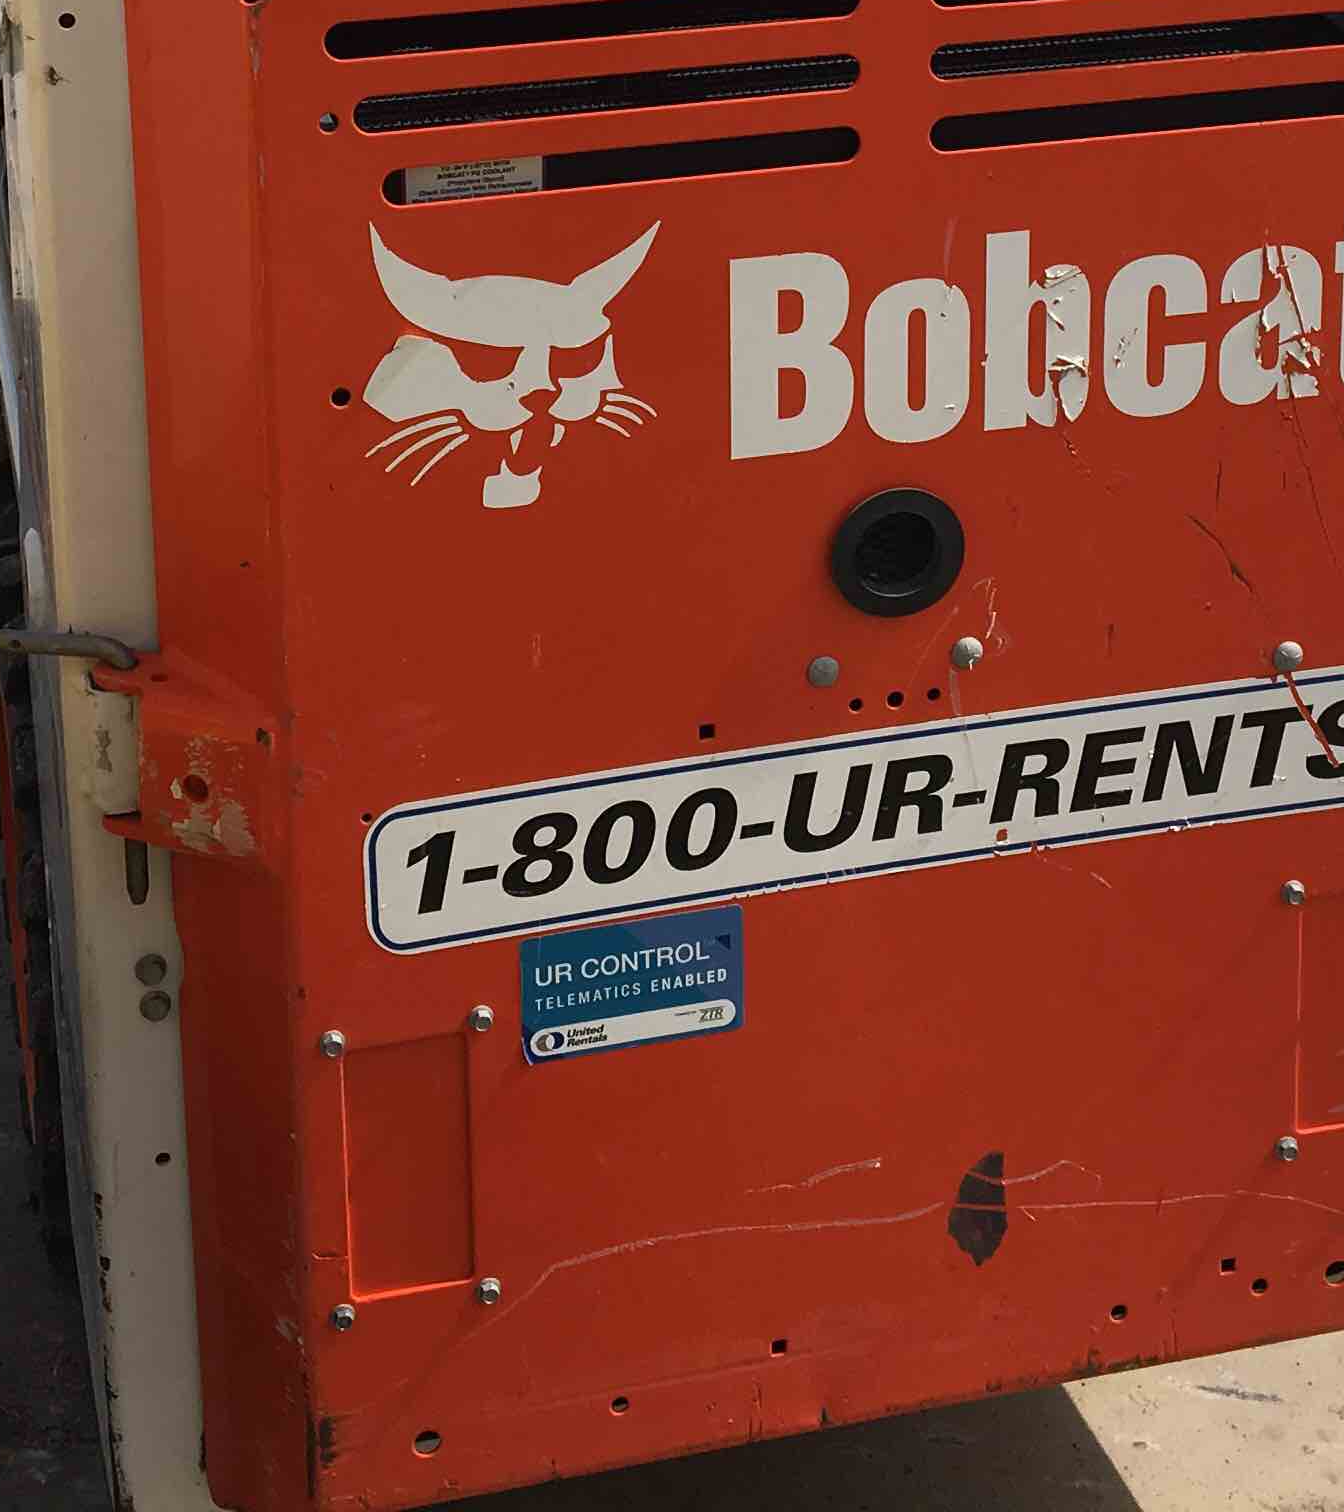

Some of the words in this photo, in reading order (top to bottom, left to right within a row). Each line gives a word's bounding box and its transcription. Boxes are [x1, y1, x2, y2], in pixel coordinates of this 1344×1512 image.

[535, 963, 572, 986] UR
[581, 941, 710, 979] CONTROL
[536, 983, 641, 1012] TELEMATICS
[651, 968, 727, 992] ENABLED
[567, 1024, 605, 1039] United
[567, 1034, 607, 1048] Rentals
